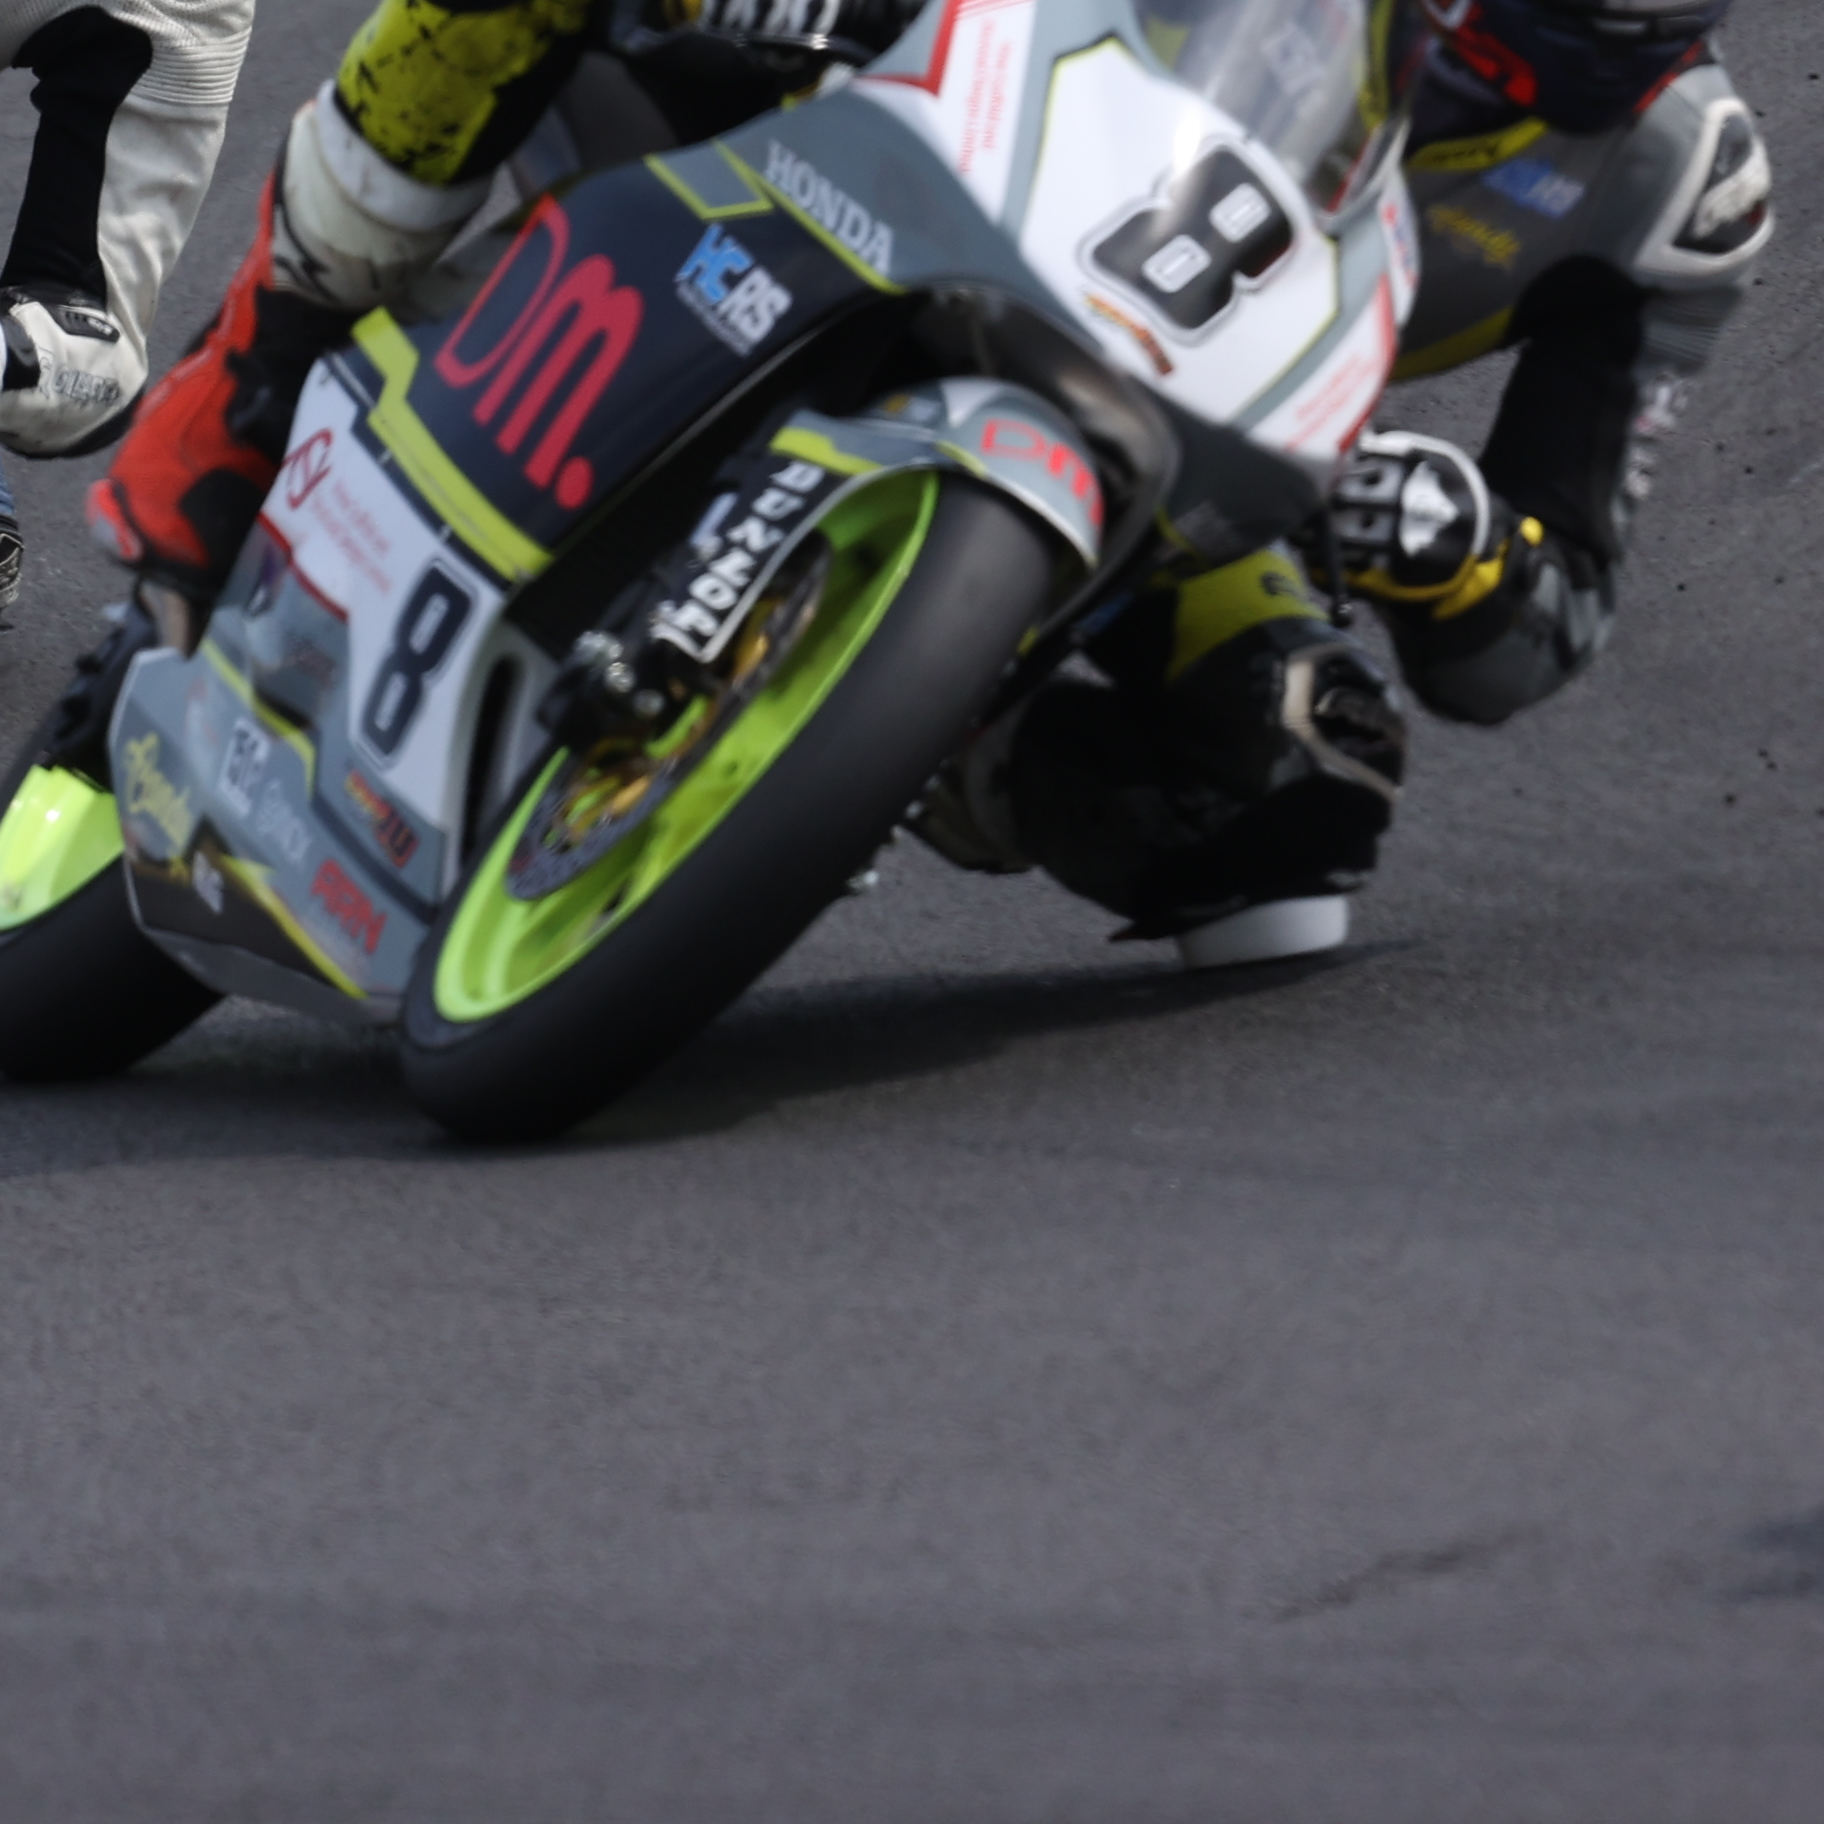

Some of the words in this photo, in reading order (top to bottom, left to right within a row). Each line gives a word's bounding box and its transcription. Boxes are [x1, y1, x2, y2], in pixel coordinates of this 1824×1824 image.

[768, 142, 893, 270] HONDA
[1091, 144, 1292, 330] 8
[670, 461, 826, 637] DUNLOP
[362, 565, 470, 756] 8
